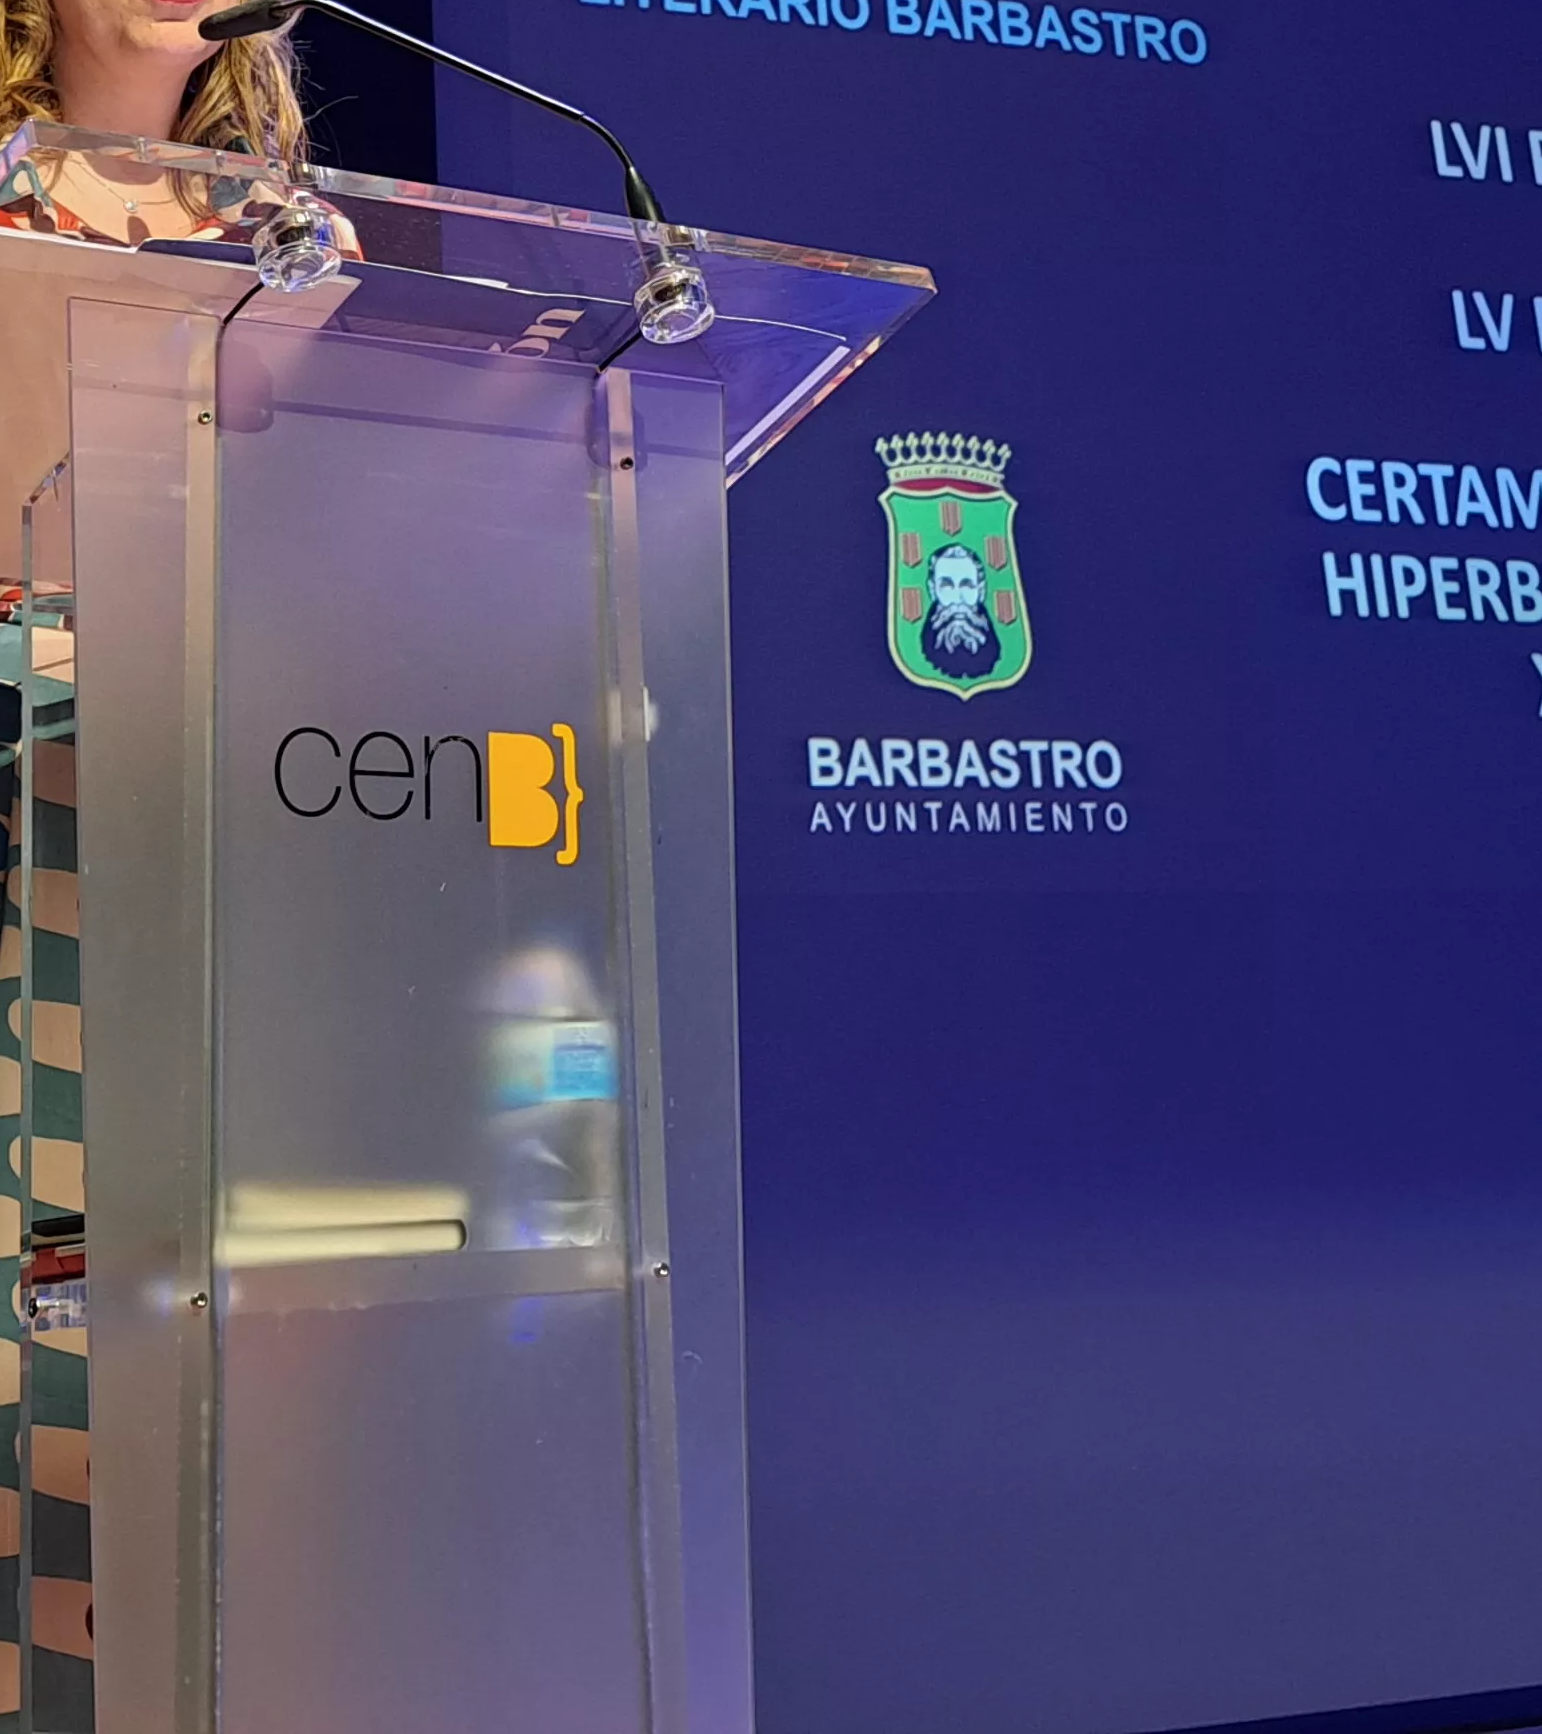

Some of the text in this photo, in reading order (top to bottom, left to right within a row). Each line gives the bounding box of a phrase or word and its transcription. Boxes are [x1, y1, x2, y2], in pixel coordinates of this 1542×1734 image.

[1430, 120, 1513, 182] LVI
[1452, 290, 1514, 352] LV
[808, 737, 1122, 789] BARBASTRO
[810, 801, 1127, 832] AYUNTAMIENTO
